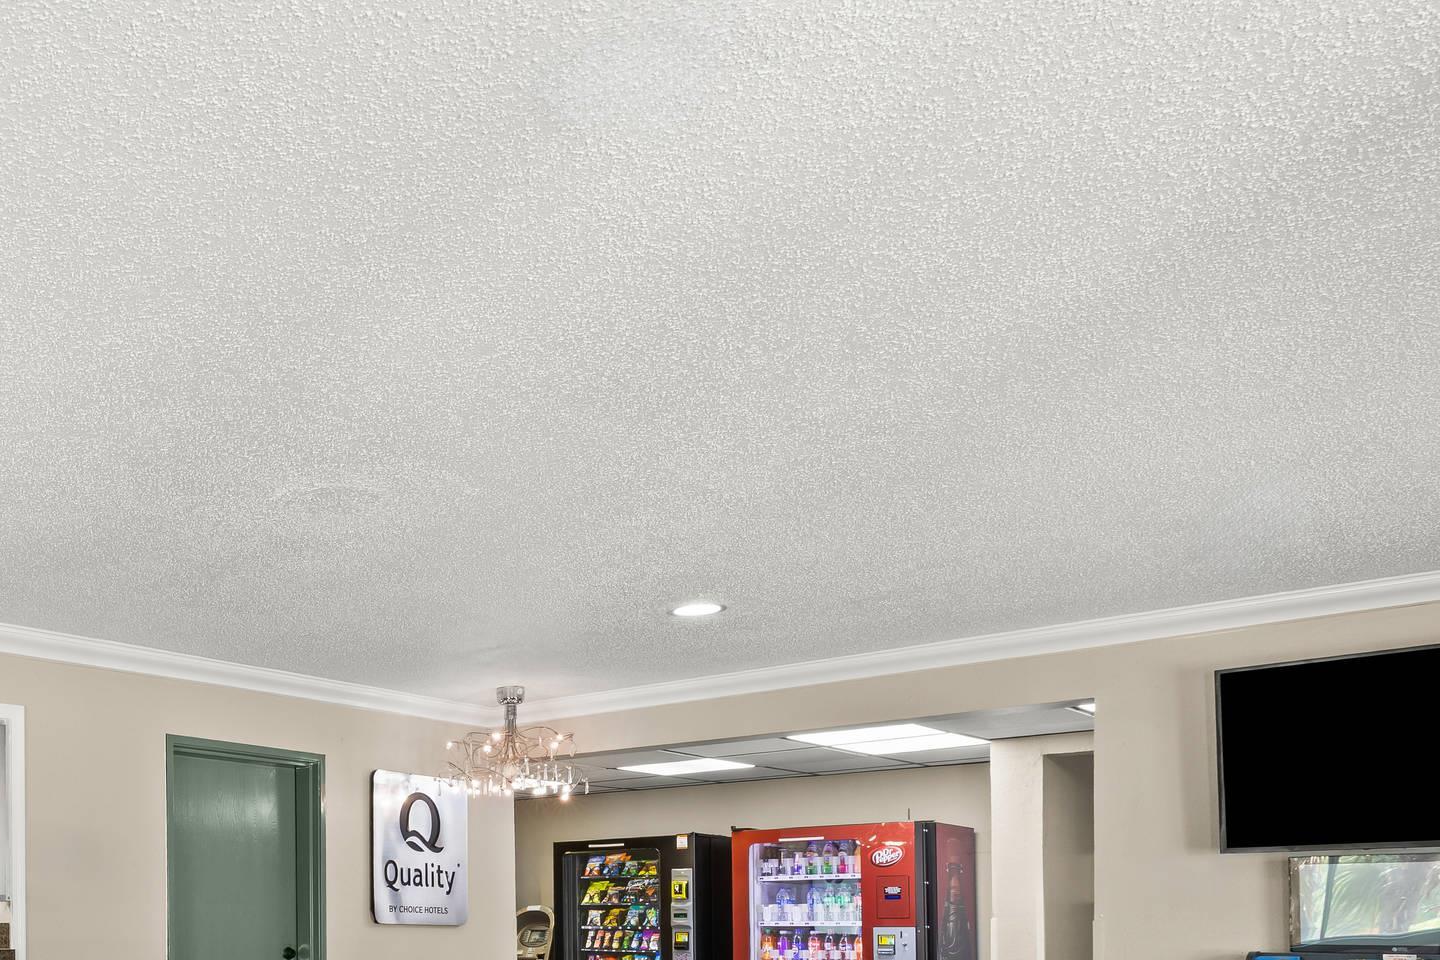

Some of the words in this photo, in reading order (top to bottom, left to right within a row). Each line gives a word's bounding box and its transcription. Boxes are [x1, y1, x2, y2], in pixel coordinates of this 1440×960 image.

[399, 792, 444, 853] Q
[384, 860, 456, 895] Quality
[388, 904, 398, 913] BY
[399, 905, 423, 914] CHOICE
[424, 906, 449, 915] HOTELS
